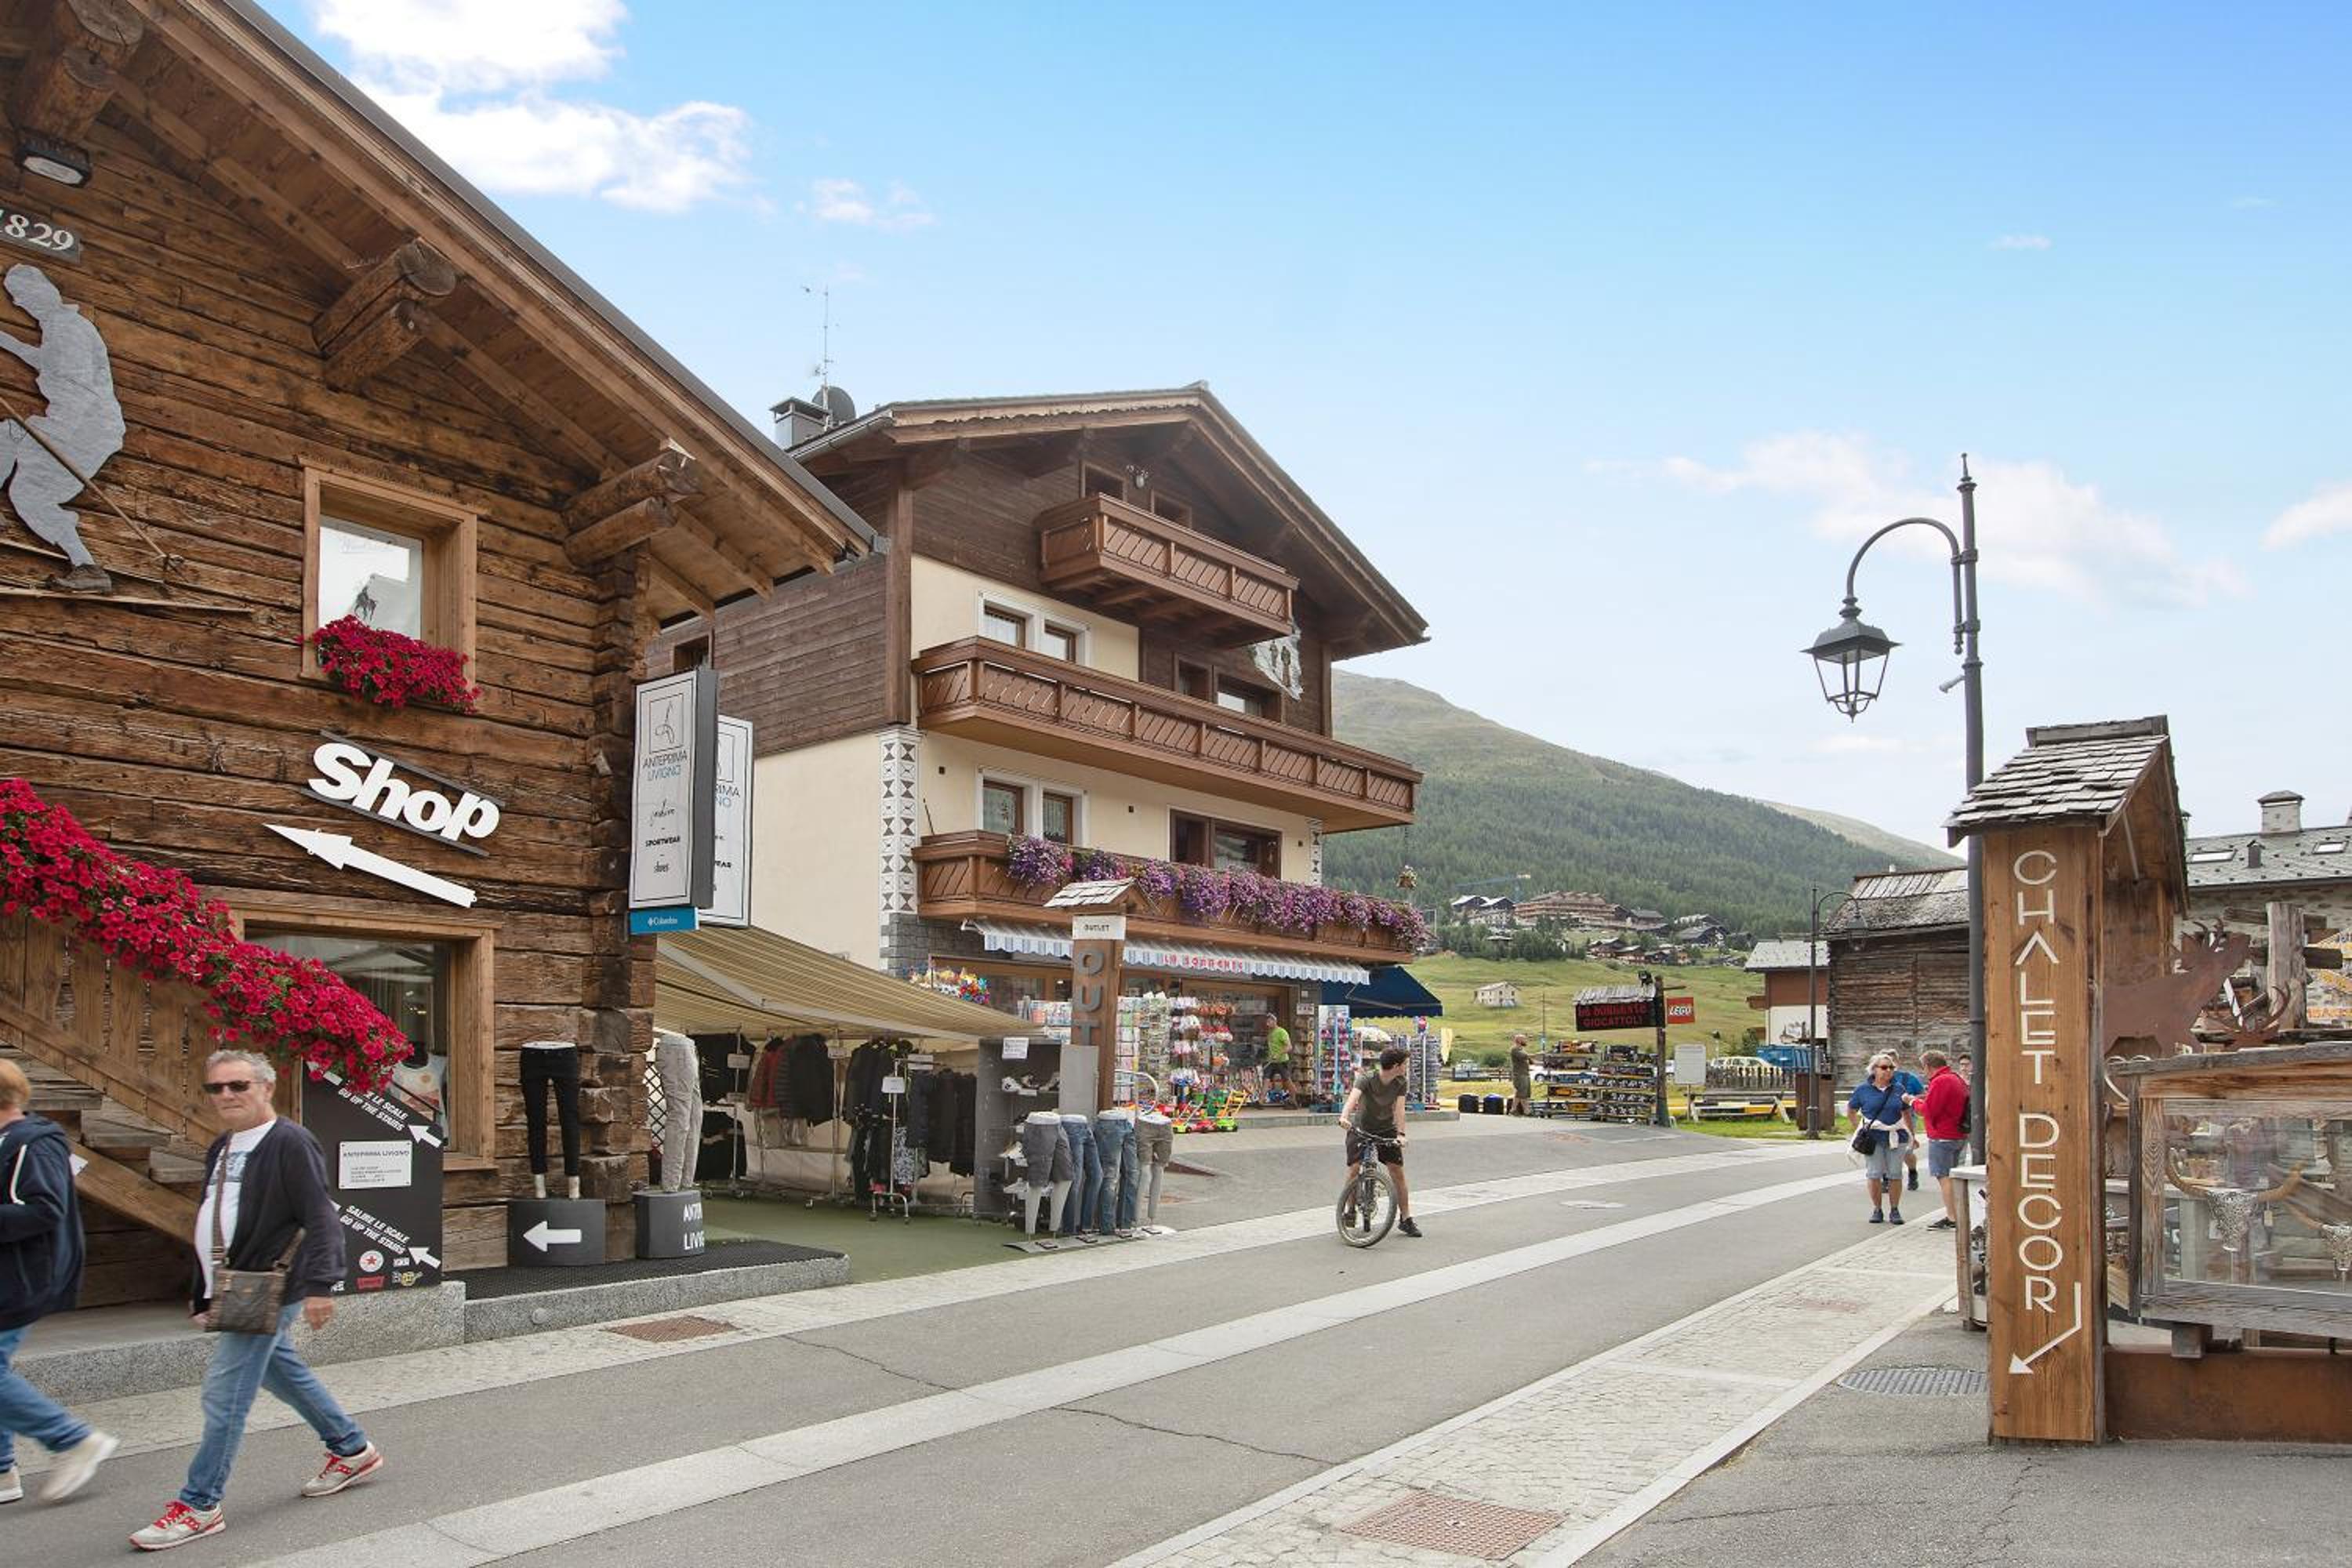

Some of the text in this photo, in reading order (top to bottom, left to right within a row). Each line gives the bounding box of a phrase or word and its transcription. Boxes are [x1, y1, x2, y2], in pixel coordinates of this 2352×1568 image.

[642, 750, 688, 769] ANTEPRIMA
[647, 764, 681, 782] LIVIGNO
[308, 742, 500, 841] Shop
[1668, 1005, 1691, 1015] LEGO
[2012, 850, 2064, 1315] CHALET DECOR
[361, 1102, 379, 1116] THE
[376, 1111, 405, 1132] STAIRS
[382, 1102, 408, 1120] SCALE
[339, 1214, 406, 1255] GO UP THE STAIRS
[346, 1205, 411, 1243] SALIRE LE SCALE
